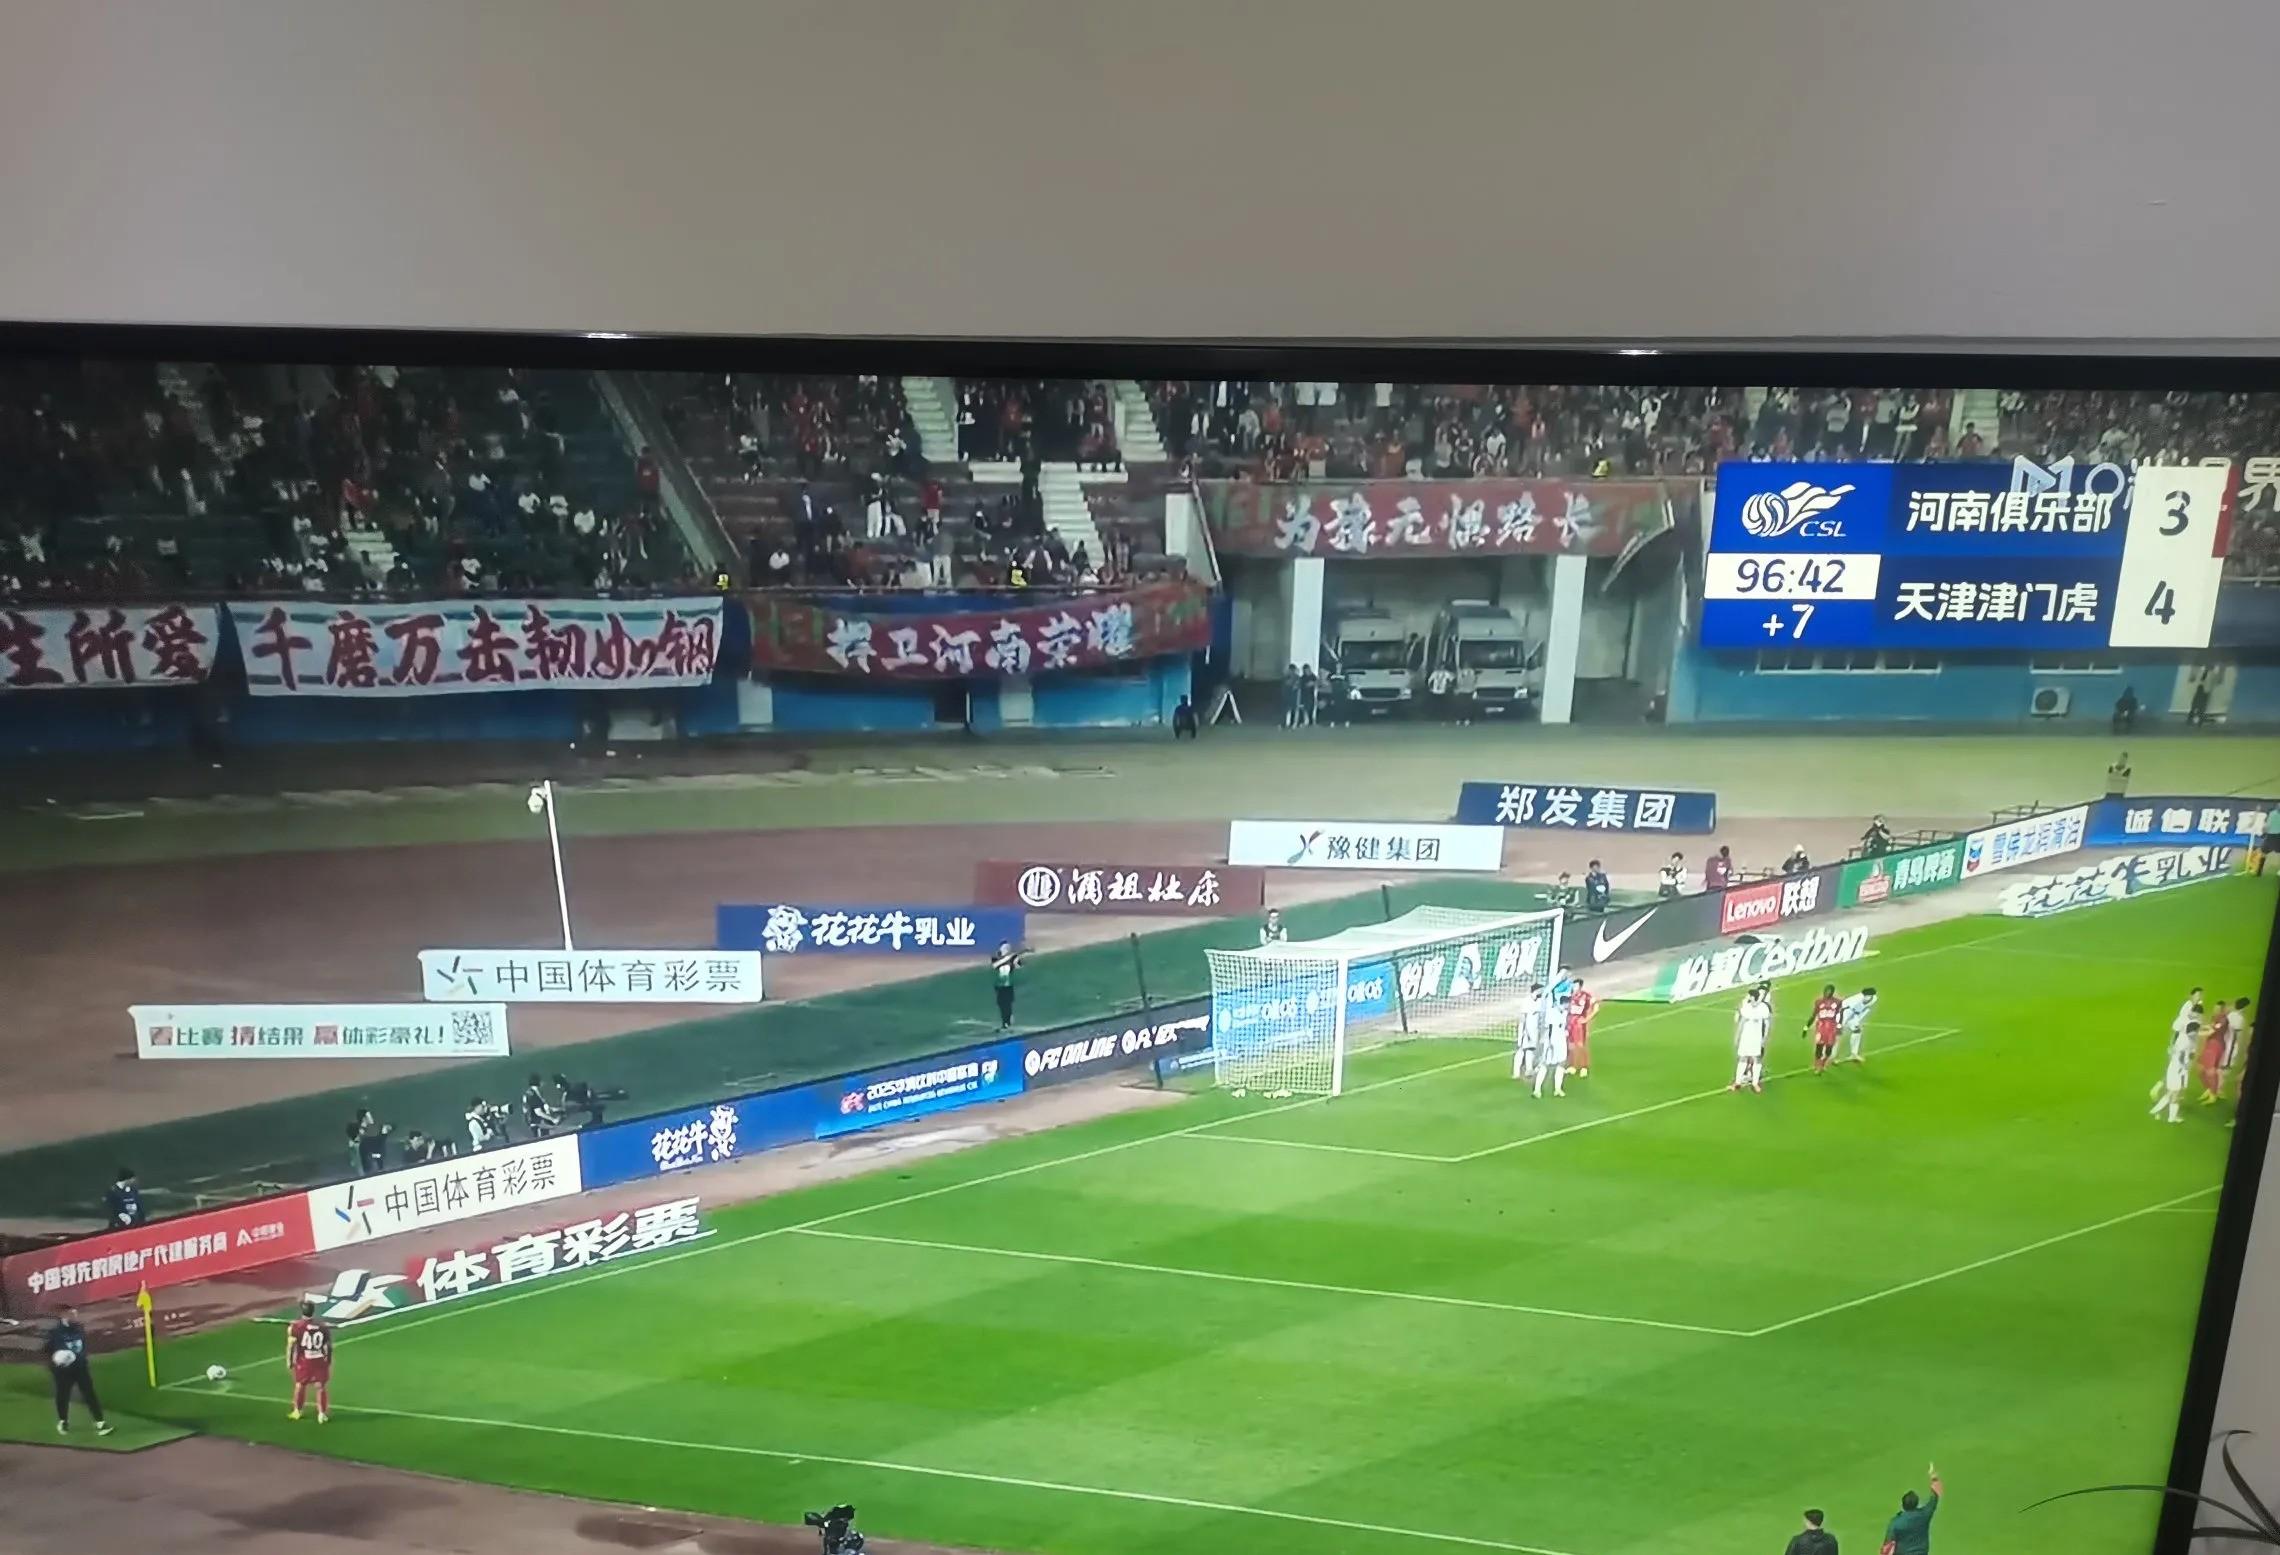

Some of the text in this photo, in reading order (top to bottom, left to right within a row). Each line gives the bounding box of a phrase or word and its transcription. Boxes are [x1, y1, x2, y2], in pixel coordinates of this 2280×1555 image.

[1800, 520, 1846, 537] CSL
[1907, 492, 2112, 533] 河南俱乐部
[2158, 491, 2190, 535] 3
[1736, 559, 1847, 595] 96:42
[1762, 605, 1813, 639] +7
[1894, 582, 2098, 623] 天津津门虎
[2144, 582, 2176, 624] 4
[825, 601, 1134, 675] 捍卫河南荣耀
[1495, 785, 1676, 831] 郑发集团
[1325, 834, 1441, 863] 豫健集团
[1067, 868, 1221, 907] 酒祖杜康
[1780, 877, 1820, 917] 联想
[1727, 897, 1778, 924] Lenovo
[810, 911, 976, 950] 花花牛乳业
[496, 959, 742, 994] 中国体育彩票
[1060, 1035, 1118, 1067] ONLINE
[385, 1150, 556, 1222] 中国体育彩票
[416, 1195, 702, 1303] 体育彩票
[300, 1331, 325, 1351] 40
